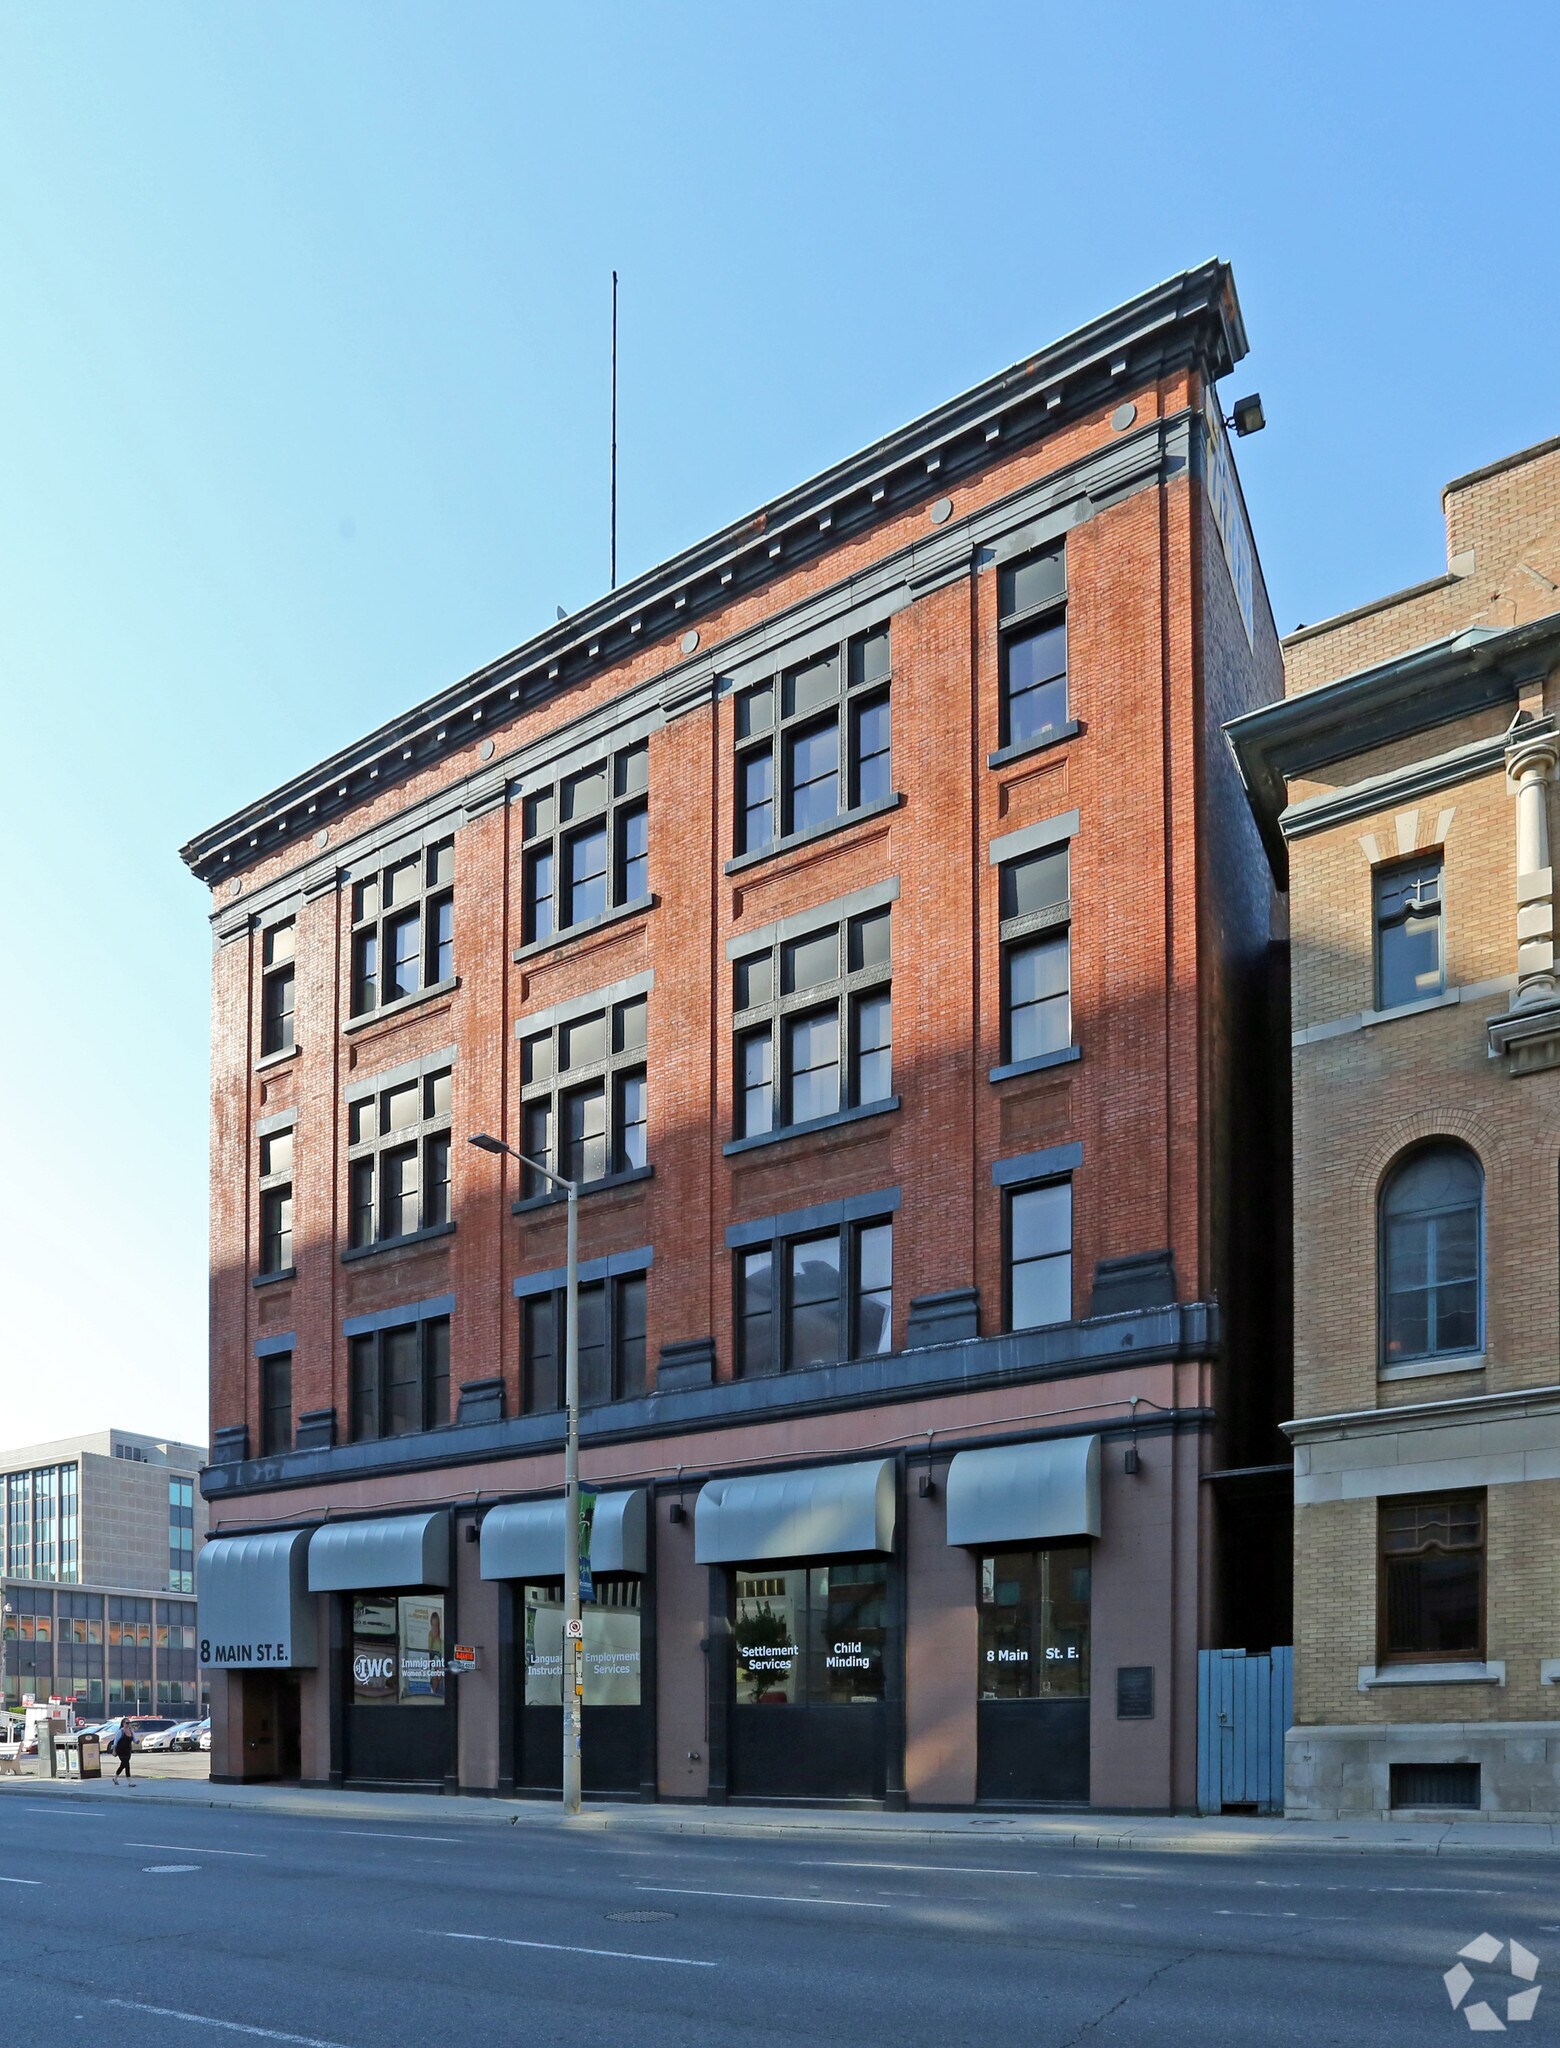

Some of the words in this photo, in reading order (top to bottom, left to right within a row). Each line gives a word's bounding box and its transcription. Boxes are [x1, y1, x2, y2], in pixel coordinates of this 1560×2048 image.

[200, 1639, 211, 1663] 8
[215, 1645, 252, 1662] MAIN
[742, 1645, 799, 1657] Settlement
[833, 1642, 862, 1654] Child
[530, 1654, 563, 1665] Langua
[585, 1652, 640, 1663] Employment
[986, 1650, 995, 1662] 8
[998, 1649, 1029, 1661] Main
[1045, 1647, 1063, 1659] St.
[1067, 1647, 1079, 1659] E.
[401, 1658, 445, 1669] Immigrant
[749, 1659, 792, 1670] Services
[826, 1656, 870, 1669] Minding
[401, 1669, 427, 1677] Women's
[426, 1669, 445, 1677] Centre
[528, 1665, 563, 1675] Instructi
[594, 1664, 630, 1674] Services
